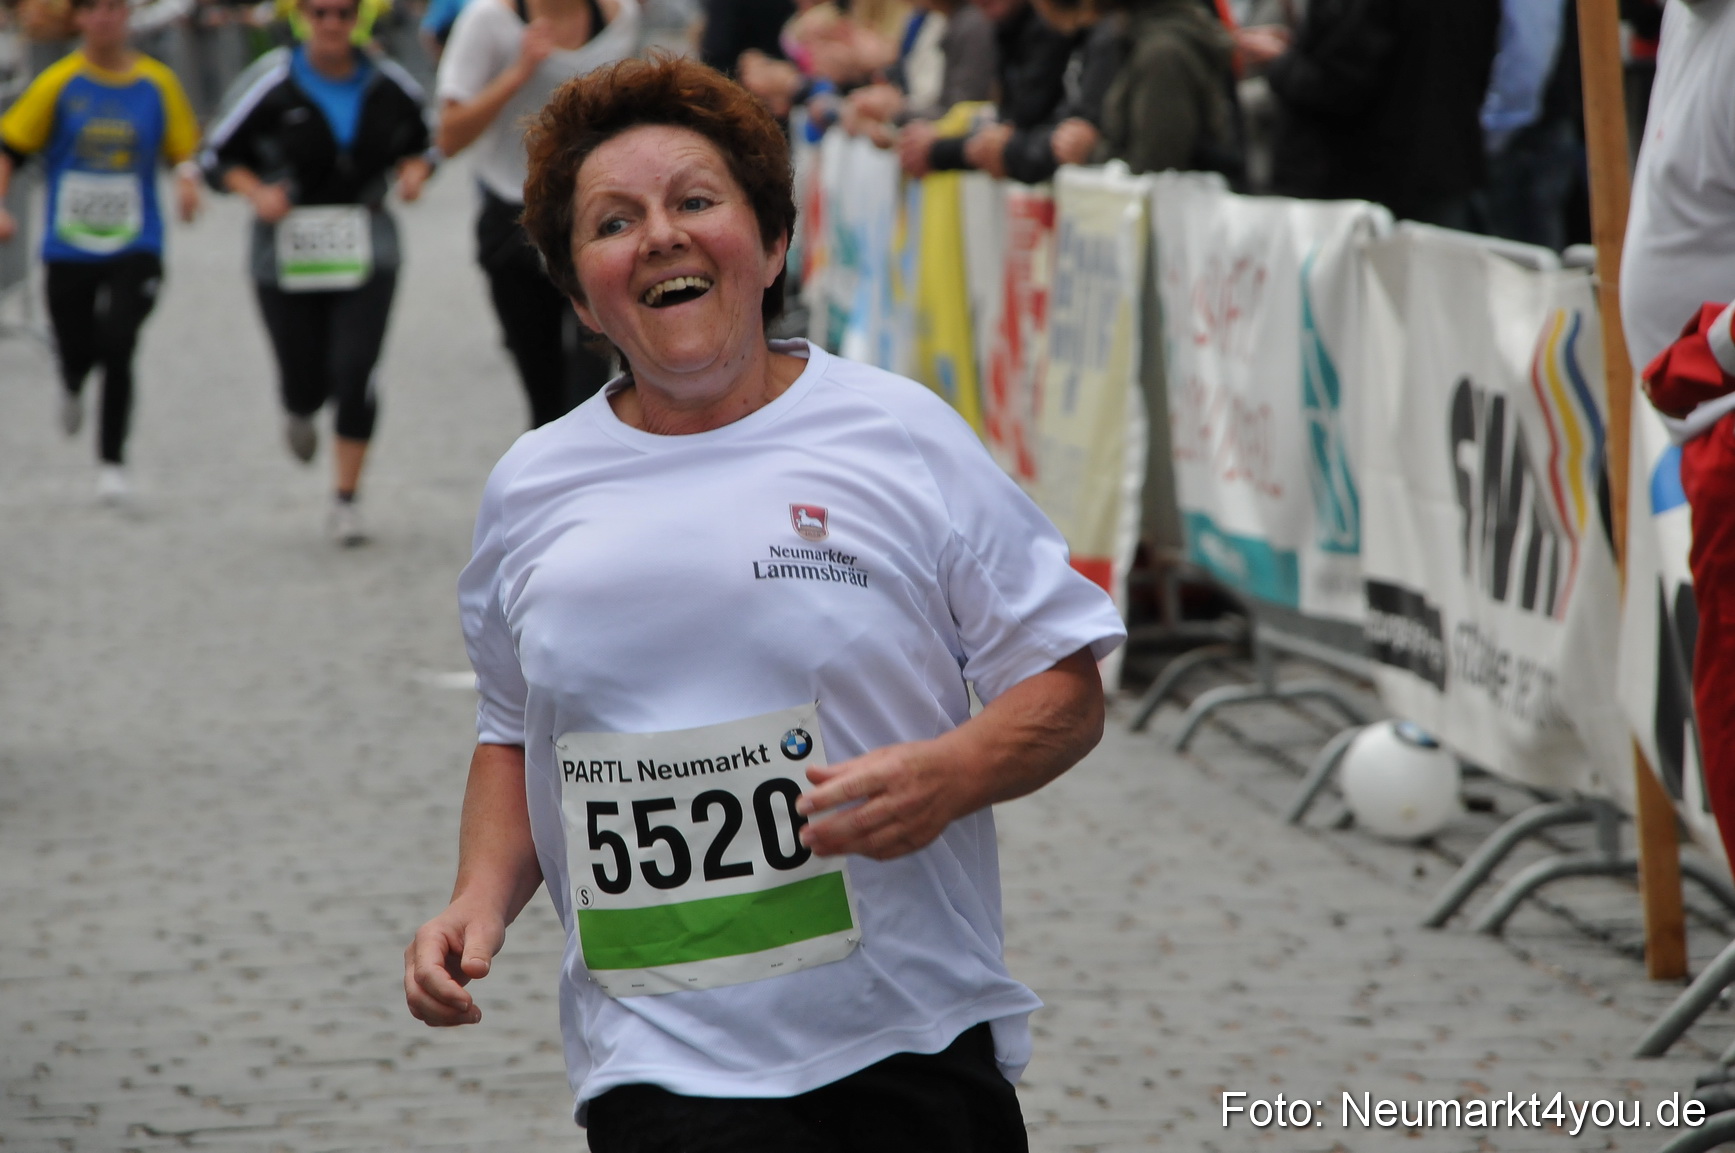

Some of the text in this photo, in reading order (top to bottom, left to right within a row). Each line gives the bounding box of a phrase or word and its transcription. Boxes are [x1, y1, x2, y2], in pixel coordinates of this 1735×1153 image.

[769, 545, 858, 566] Neumarkter
[752, 561, 869, 589] Lammsbräu
[562, 743, 771, 783] PARTL Neumarkt
[586, 777, 812, 895] 5520
